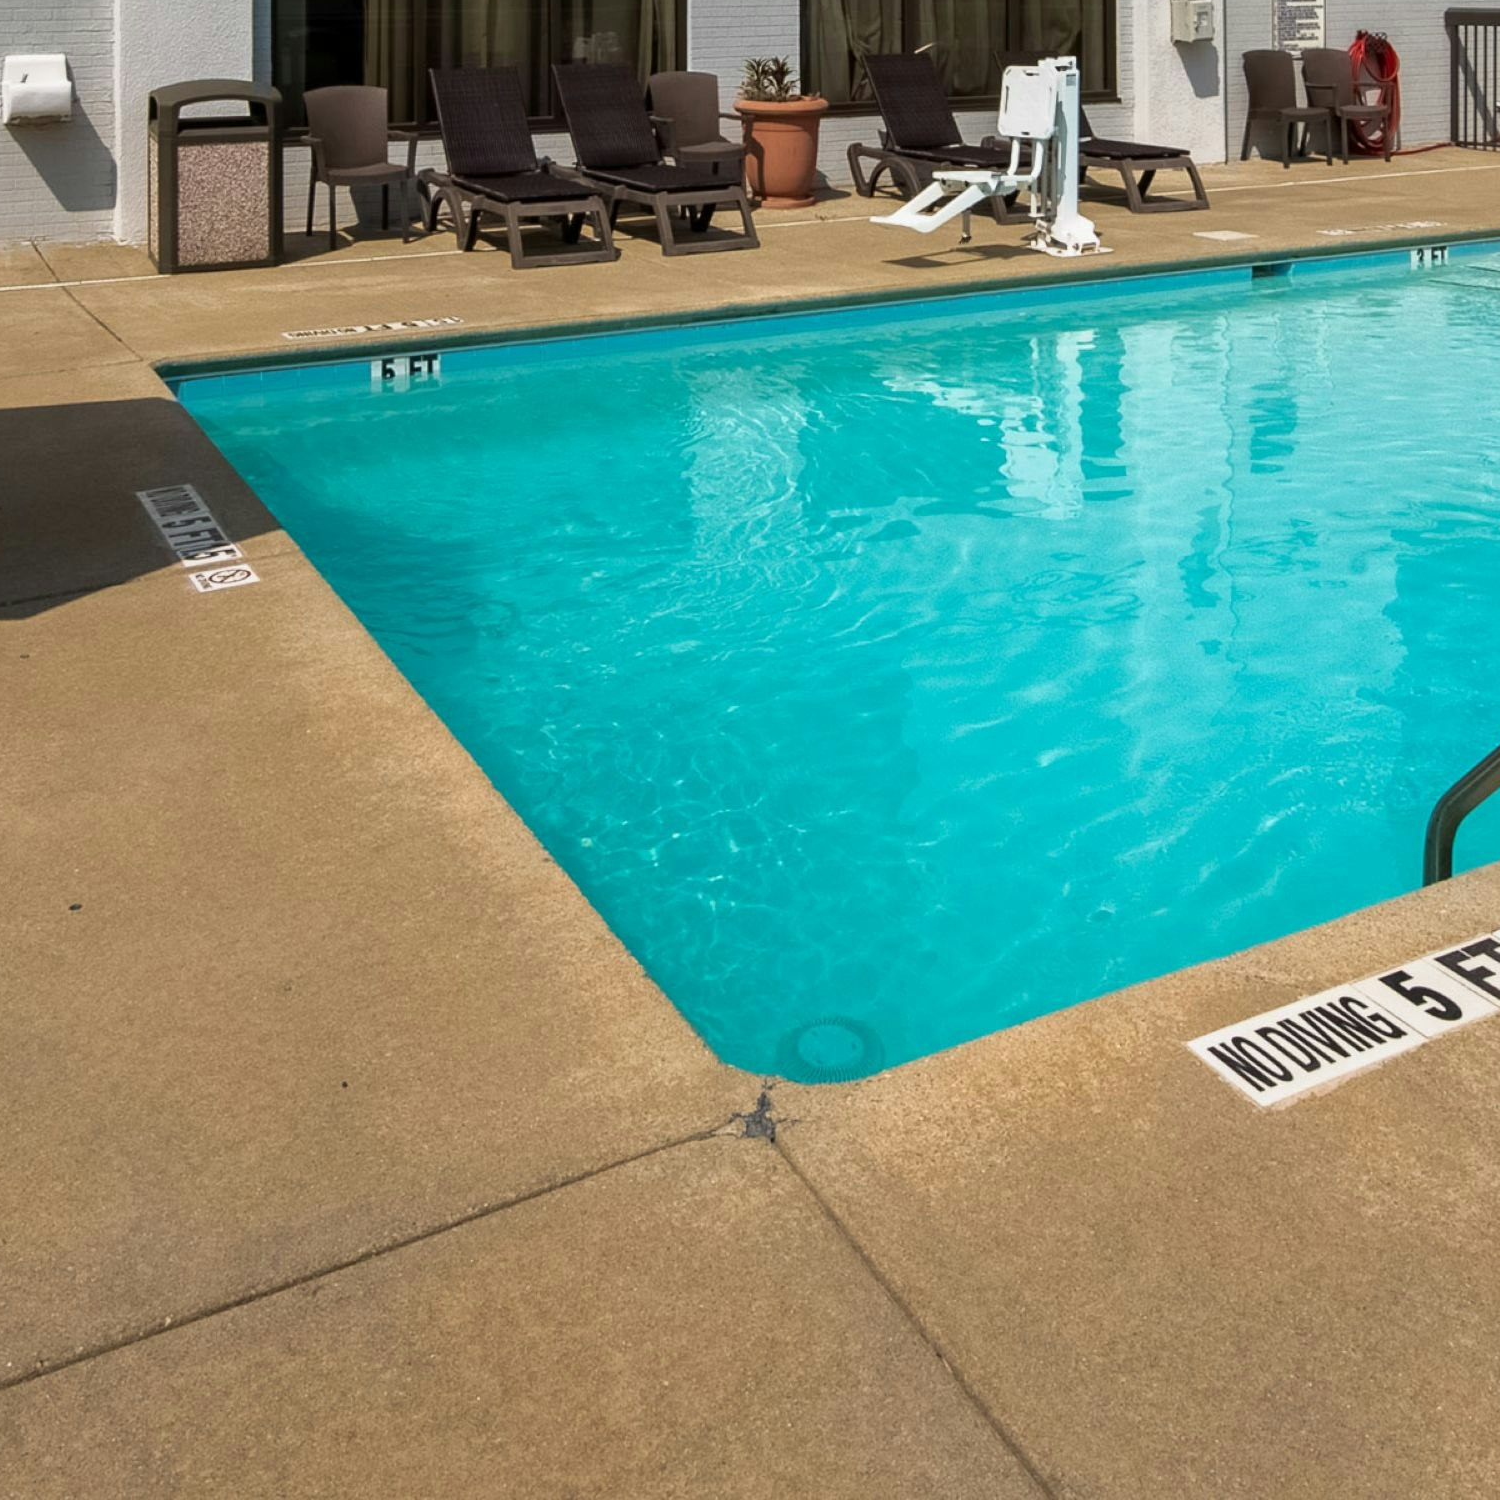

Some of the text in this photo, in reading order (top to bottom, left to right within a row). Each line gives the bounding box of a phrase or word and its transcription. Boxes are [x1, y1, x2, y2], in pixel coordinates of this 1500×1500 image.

[409, 354, 438, 376] FT
[1207, 1036, 1294, 1092] NO
[1267, 995, 1407, 1073] DIVING
[1379, 970, 1463, 1021] 5
